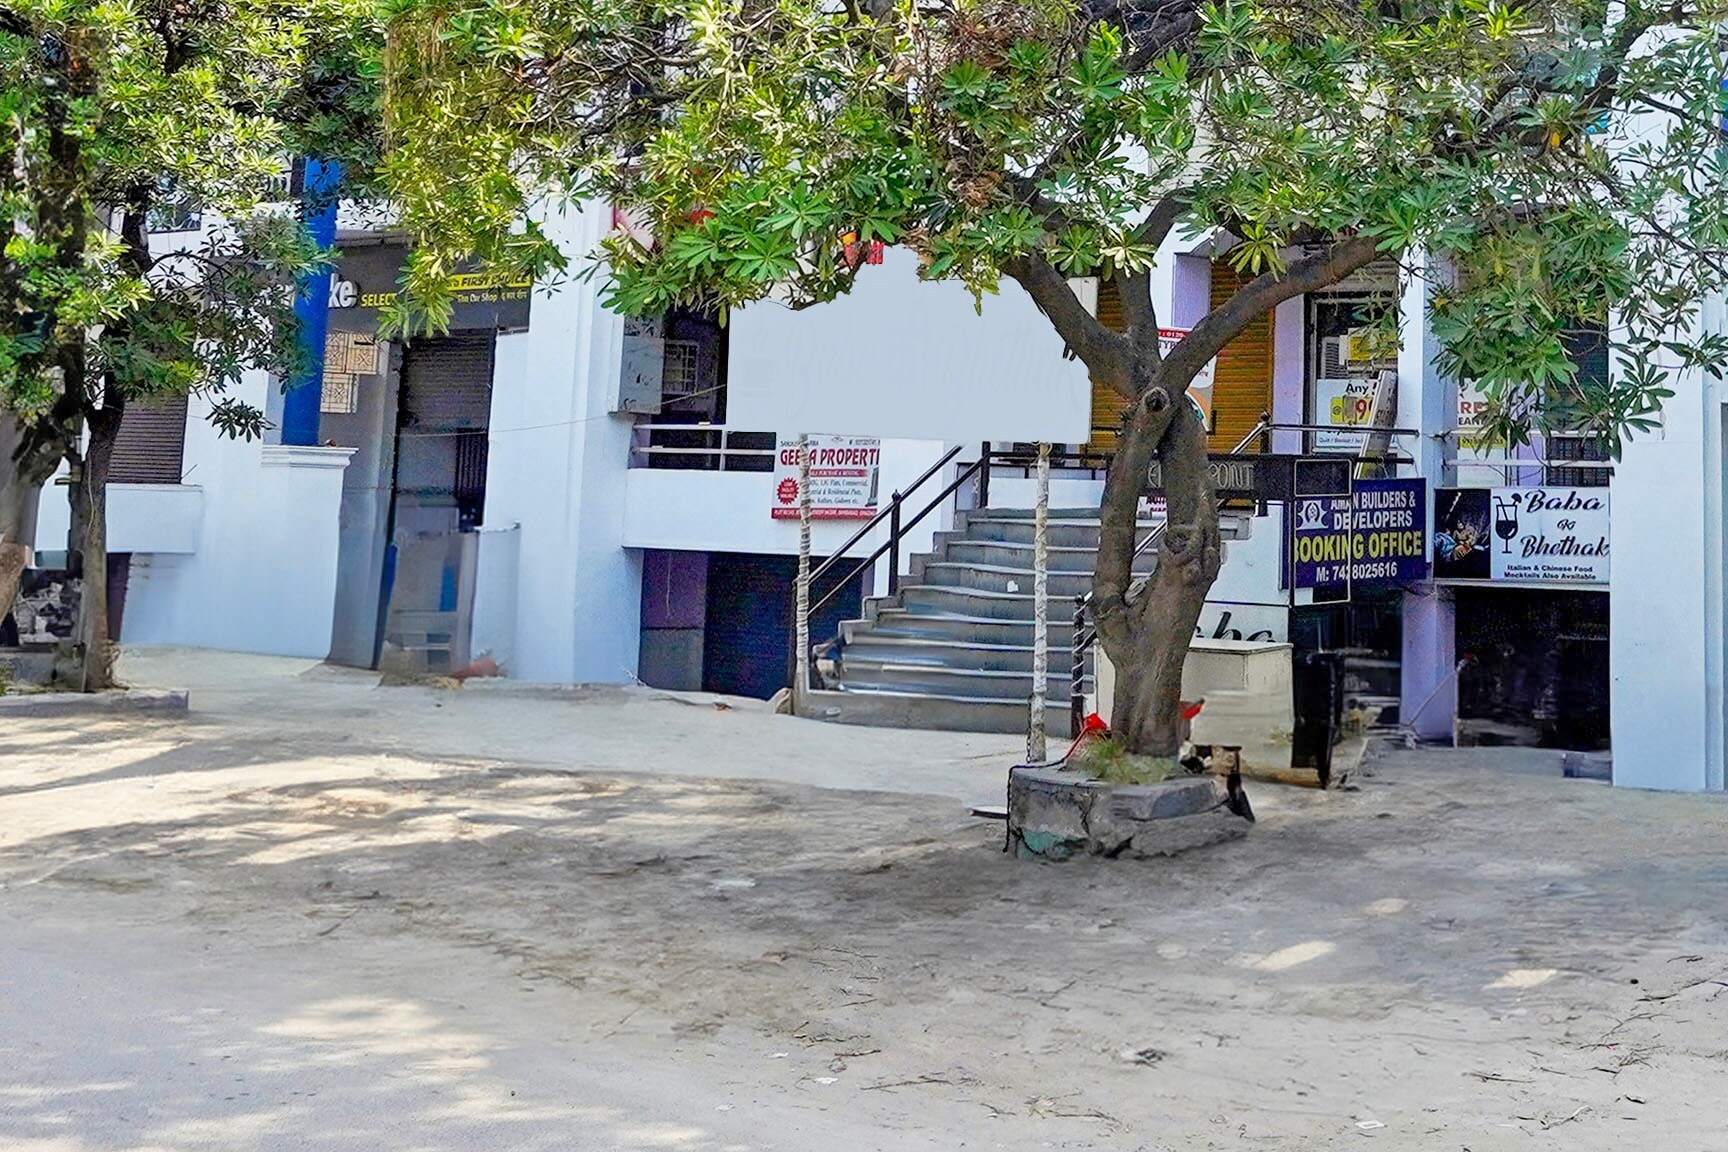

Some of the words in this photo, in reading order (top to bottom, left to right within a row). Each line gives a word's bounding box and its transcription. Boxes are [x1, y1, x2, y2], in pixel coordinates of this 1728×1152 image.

[461, 276, 491, 287] FIRST
[1345, 382, 1370, 395] Any
[780, 448, 818, 466] GEEA
[1361, 490, 1408, 510] BUILDERS
[1408, 490, 1416, 508] &
[1525, 489, 1607, 513] Baba
[1333, 510, 1413, 531] DEVELOPERS
[1368, 530, 1423, 559] OFFICE
[1519, 534, 1610, 559] Bhethak
[1507, 564, 1532, 572] Italian
[1541, 564, 1573, 573] Chinese
[1574, 564, 1593, 573] Food
[1541, 572, 1560, 580] Also
[1560, 572, 1597, 581] Available
